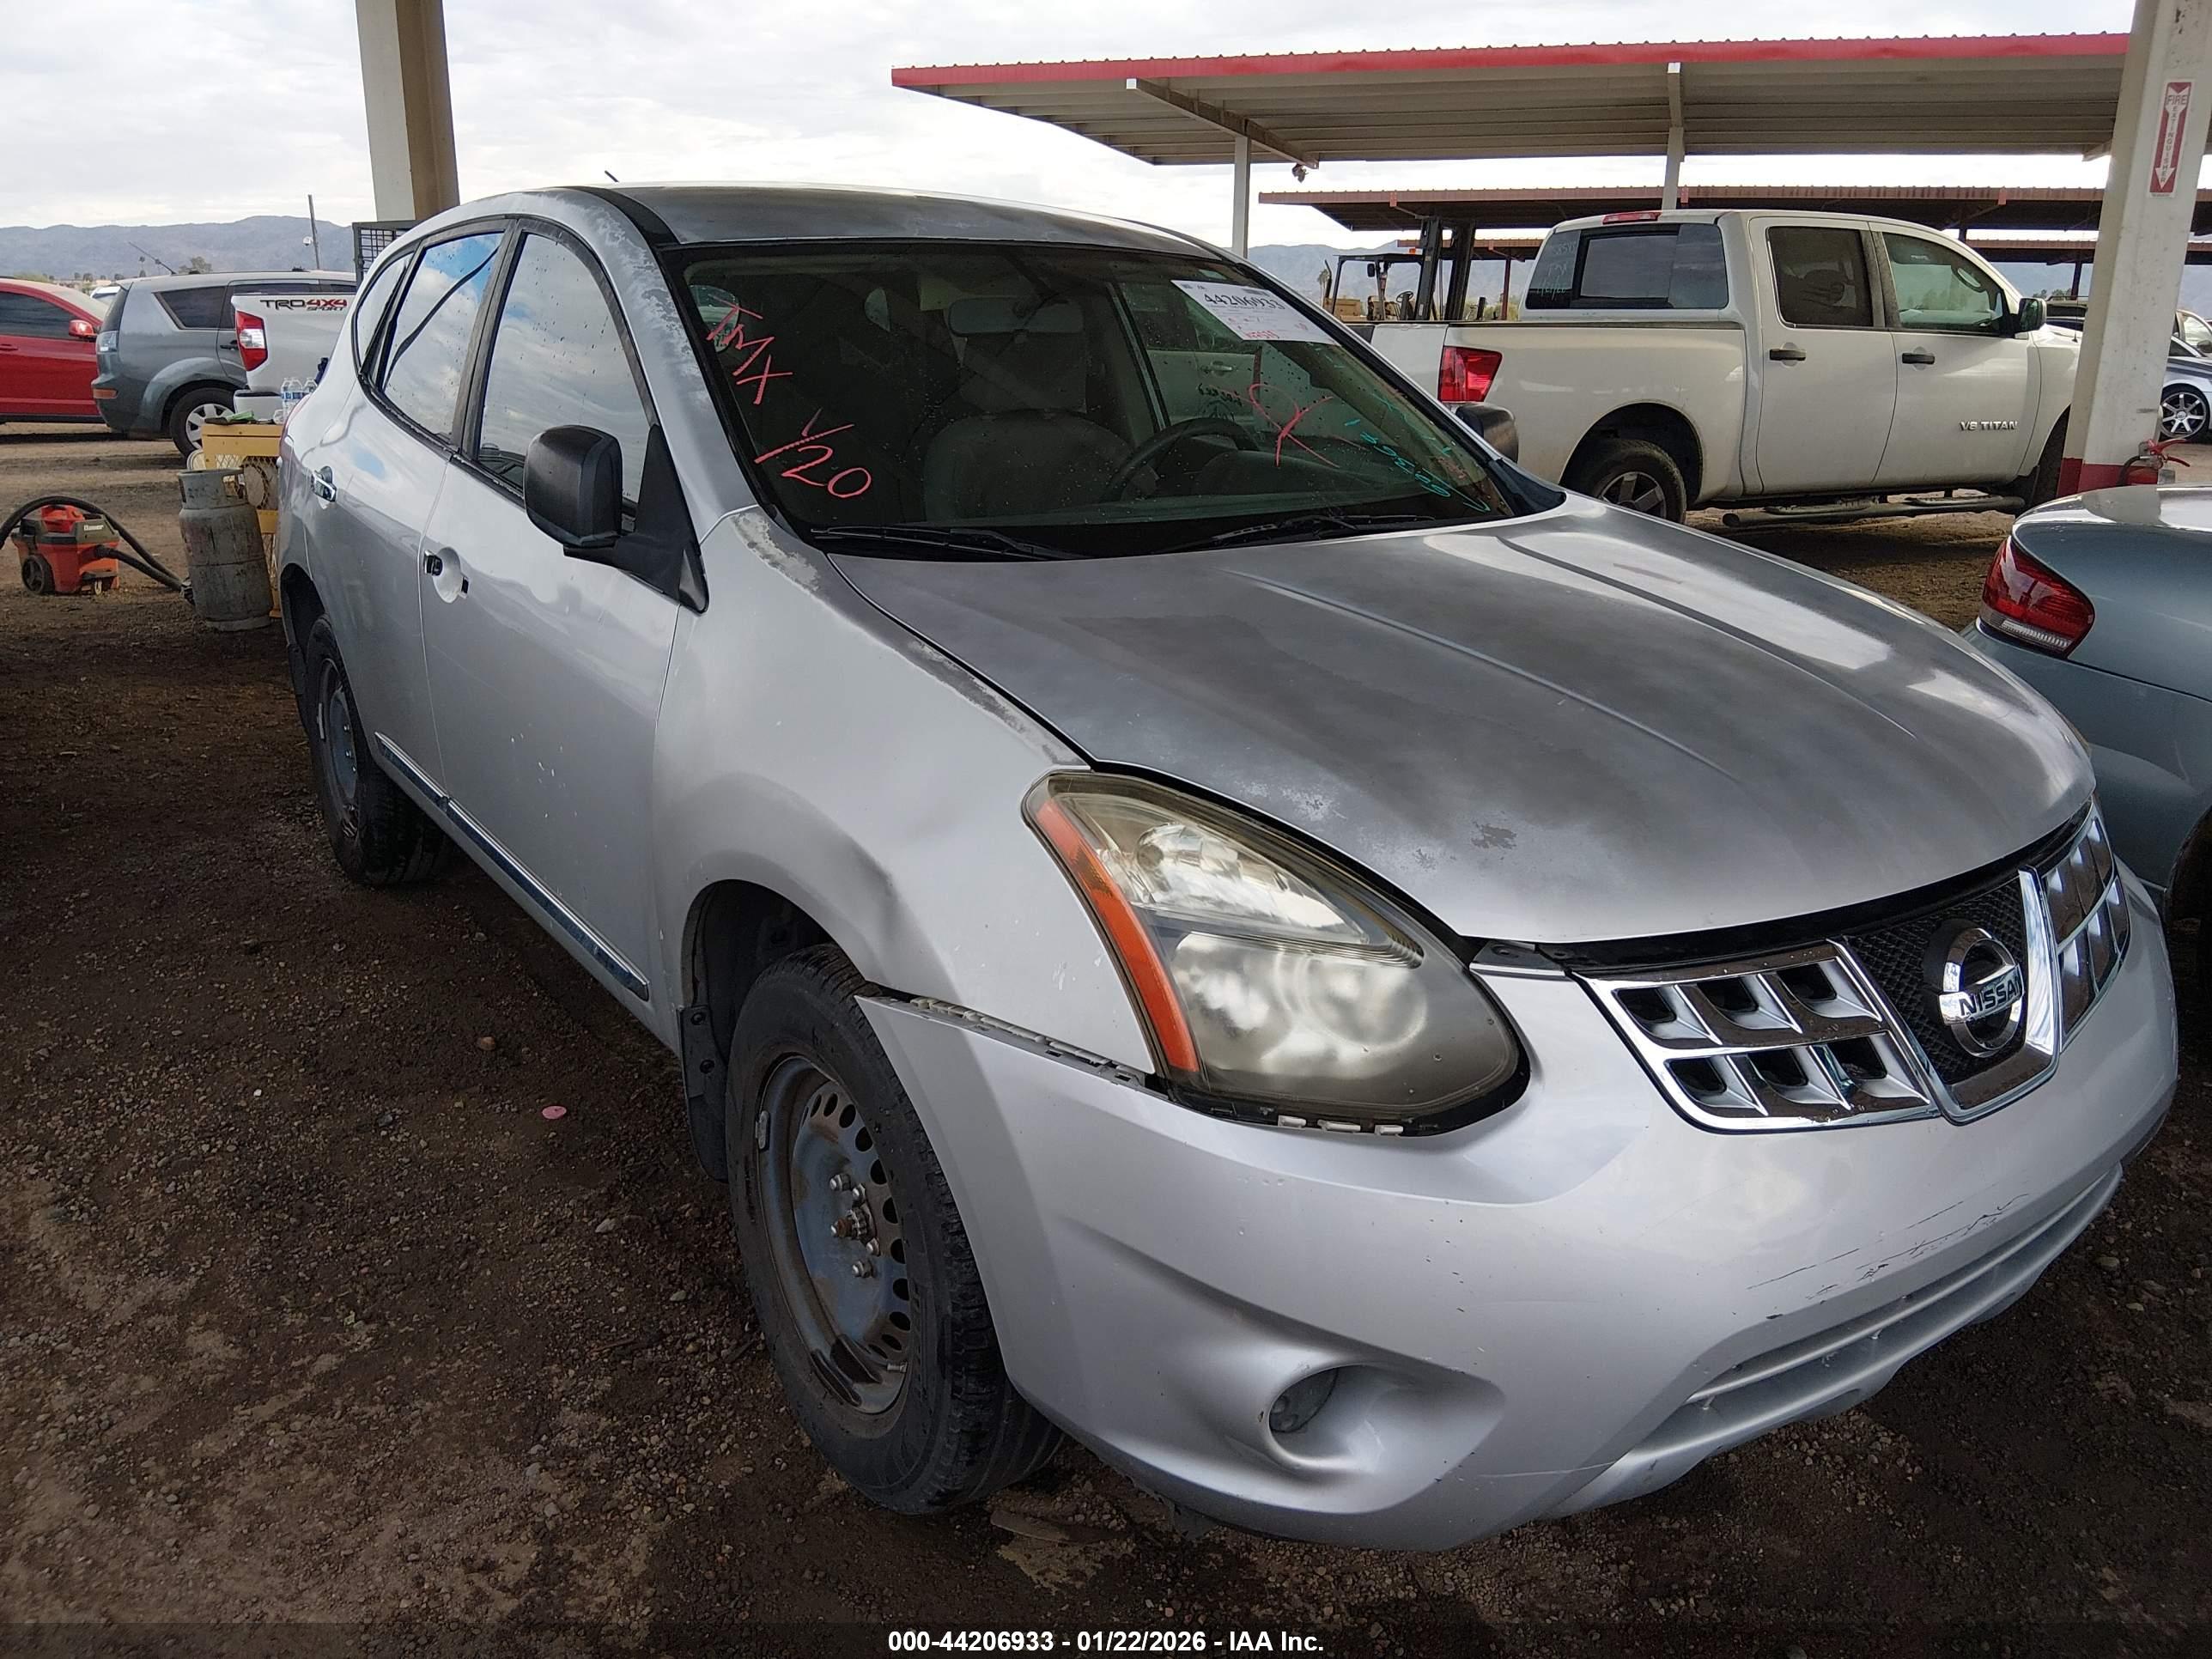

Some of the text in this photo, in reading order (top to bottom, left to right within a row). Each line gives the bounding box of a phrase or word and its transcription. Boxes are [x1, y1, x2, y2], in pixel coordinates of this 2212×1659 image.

[2166, 95, 2188, 105] FIRE
[2160, 106, 2178, 183] EXTINGUISHER
[1960, 421, 2019, 431] V8 TITAN
